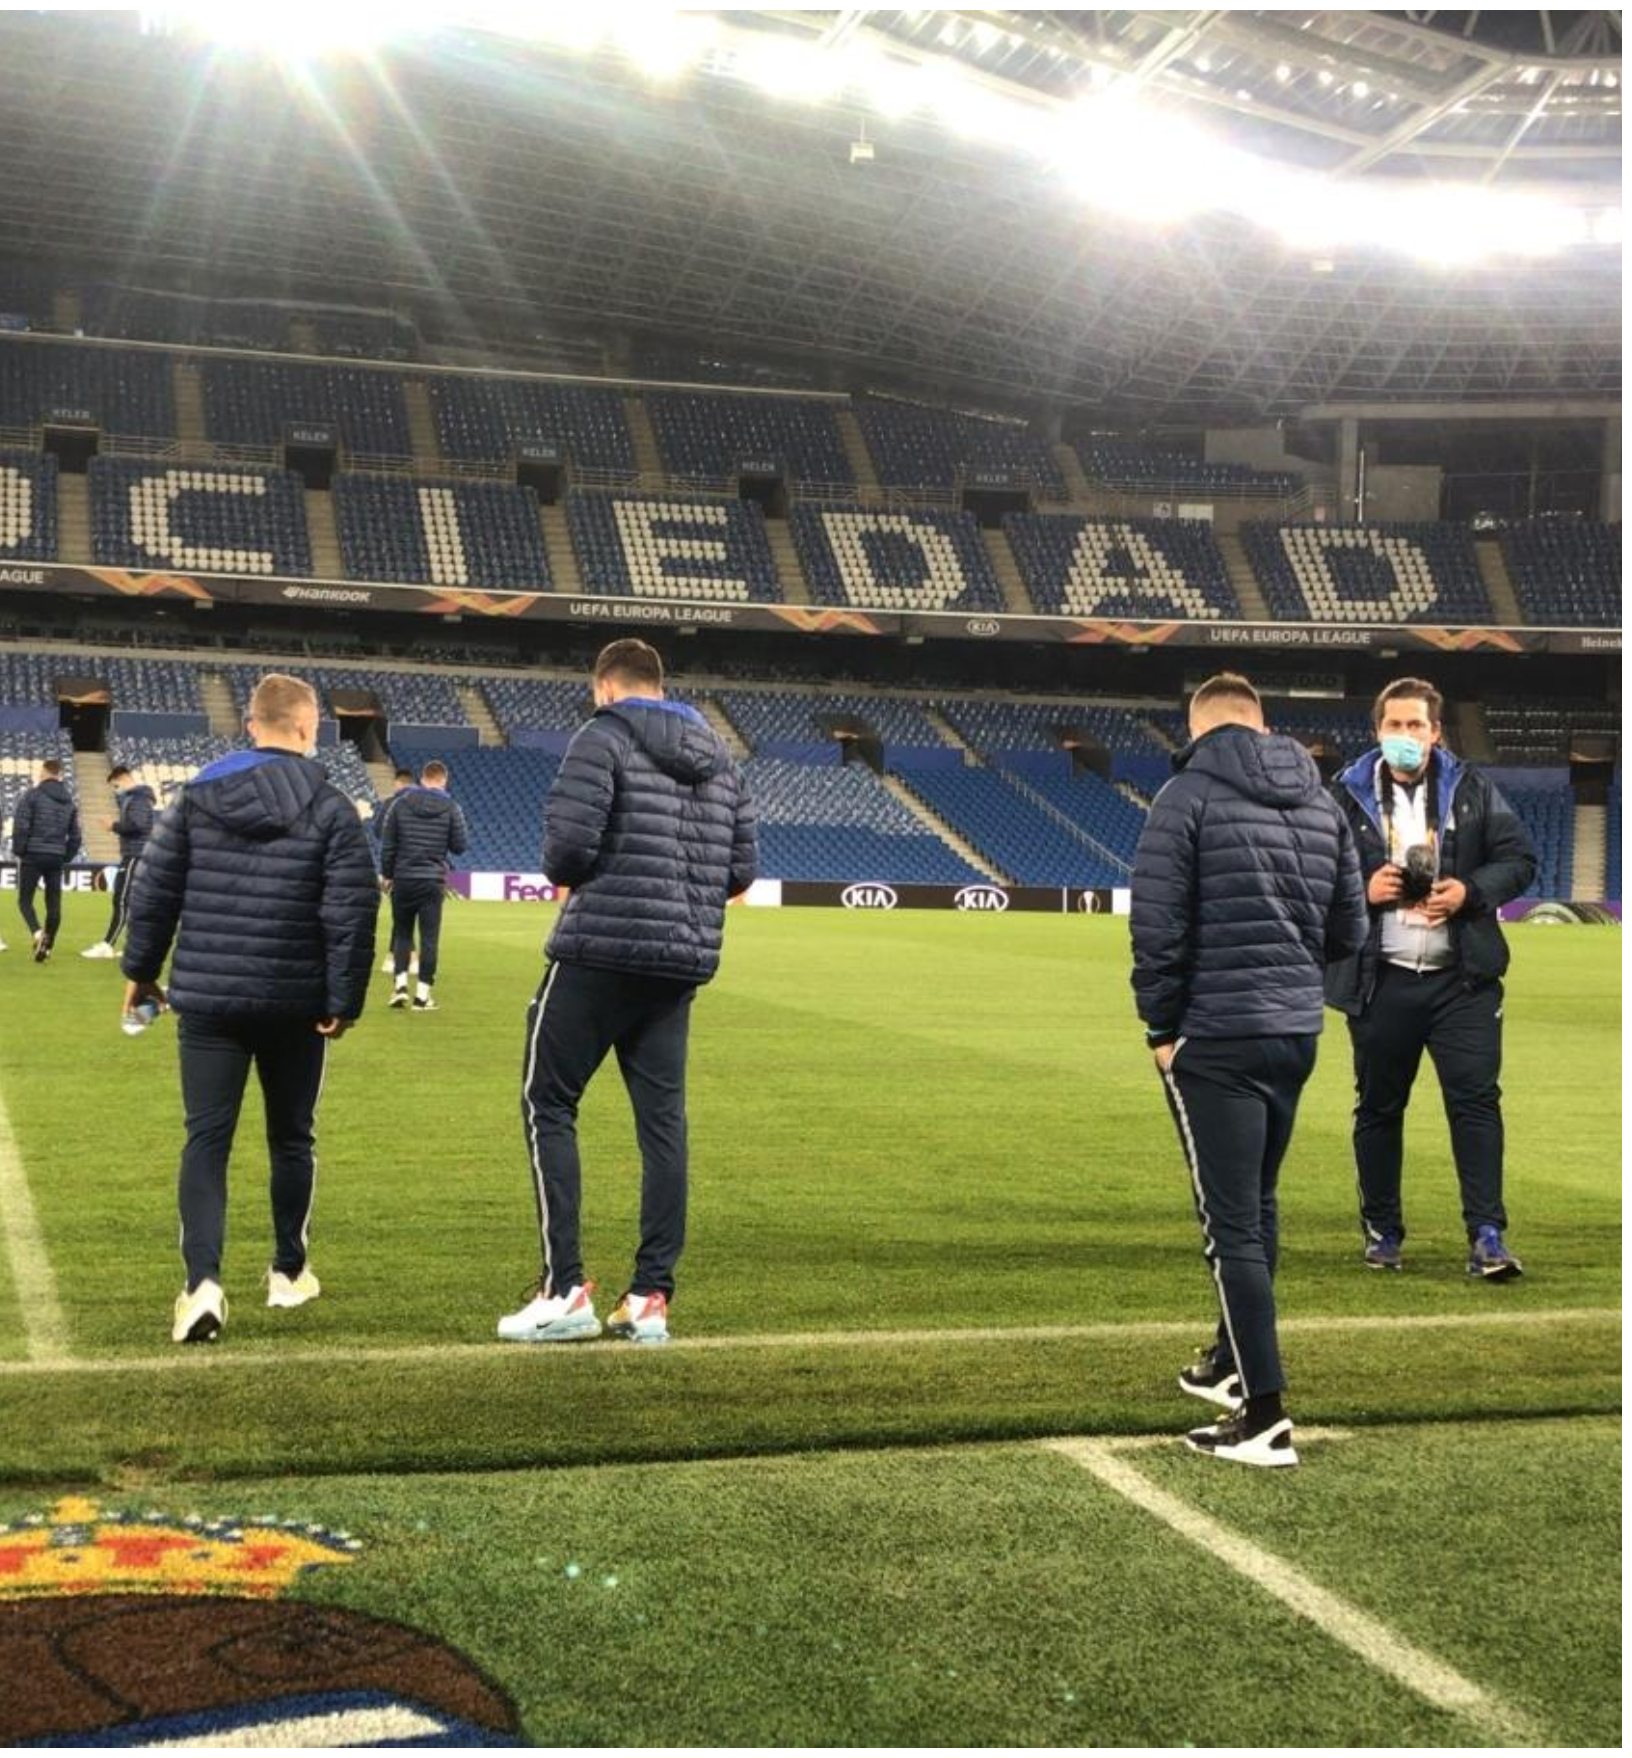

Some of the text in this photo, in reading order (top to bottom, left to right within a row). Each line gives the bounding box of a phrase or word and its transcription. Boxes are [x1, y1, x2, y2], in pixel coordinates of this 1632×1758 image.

[570, 602, 733, 623] UEFA EUROPA LEAGUE
[1210, 628, 1371, 645] UEFA EUROPA LEAGUE
